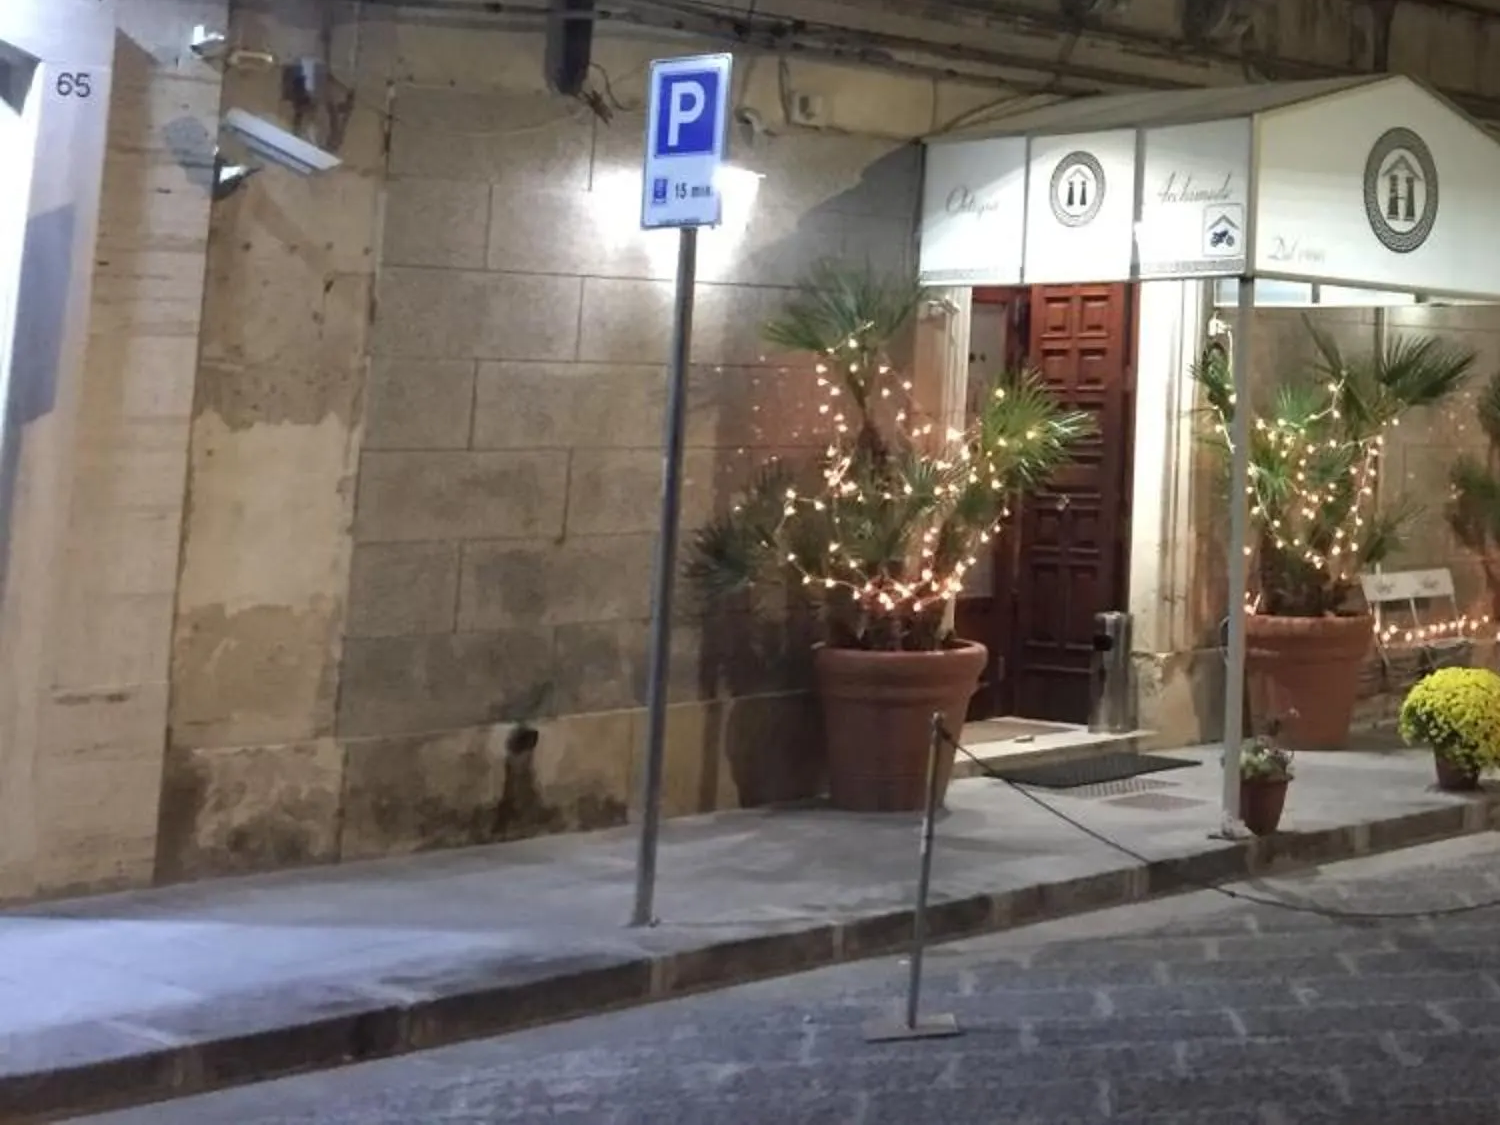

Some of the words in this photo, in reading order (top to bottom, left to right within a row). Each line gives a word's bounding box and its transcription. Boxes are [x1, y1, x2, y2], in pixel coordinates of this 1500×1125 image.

[56, 72, 91, 98] 65
[667, 81, 706, 147] P
[675, 182, 687, 200] 15
